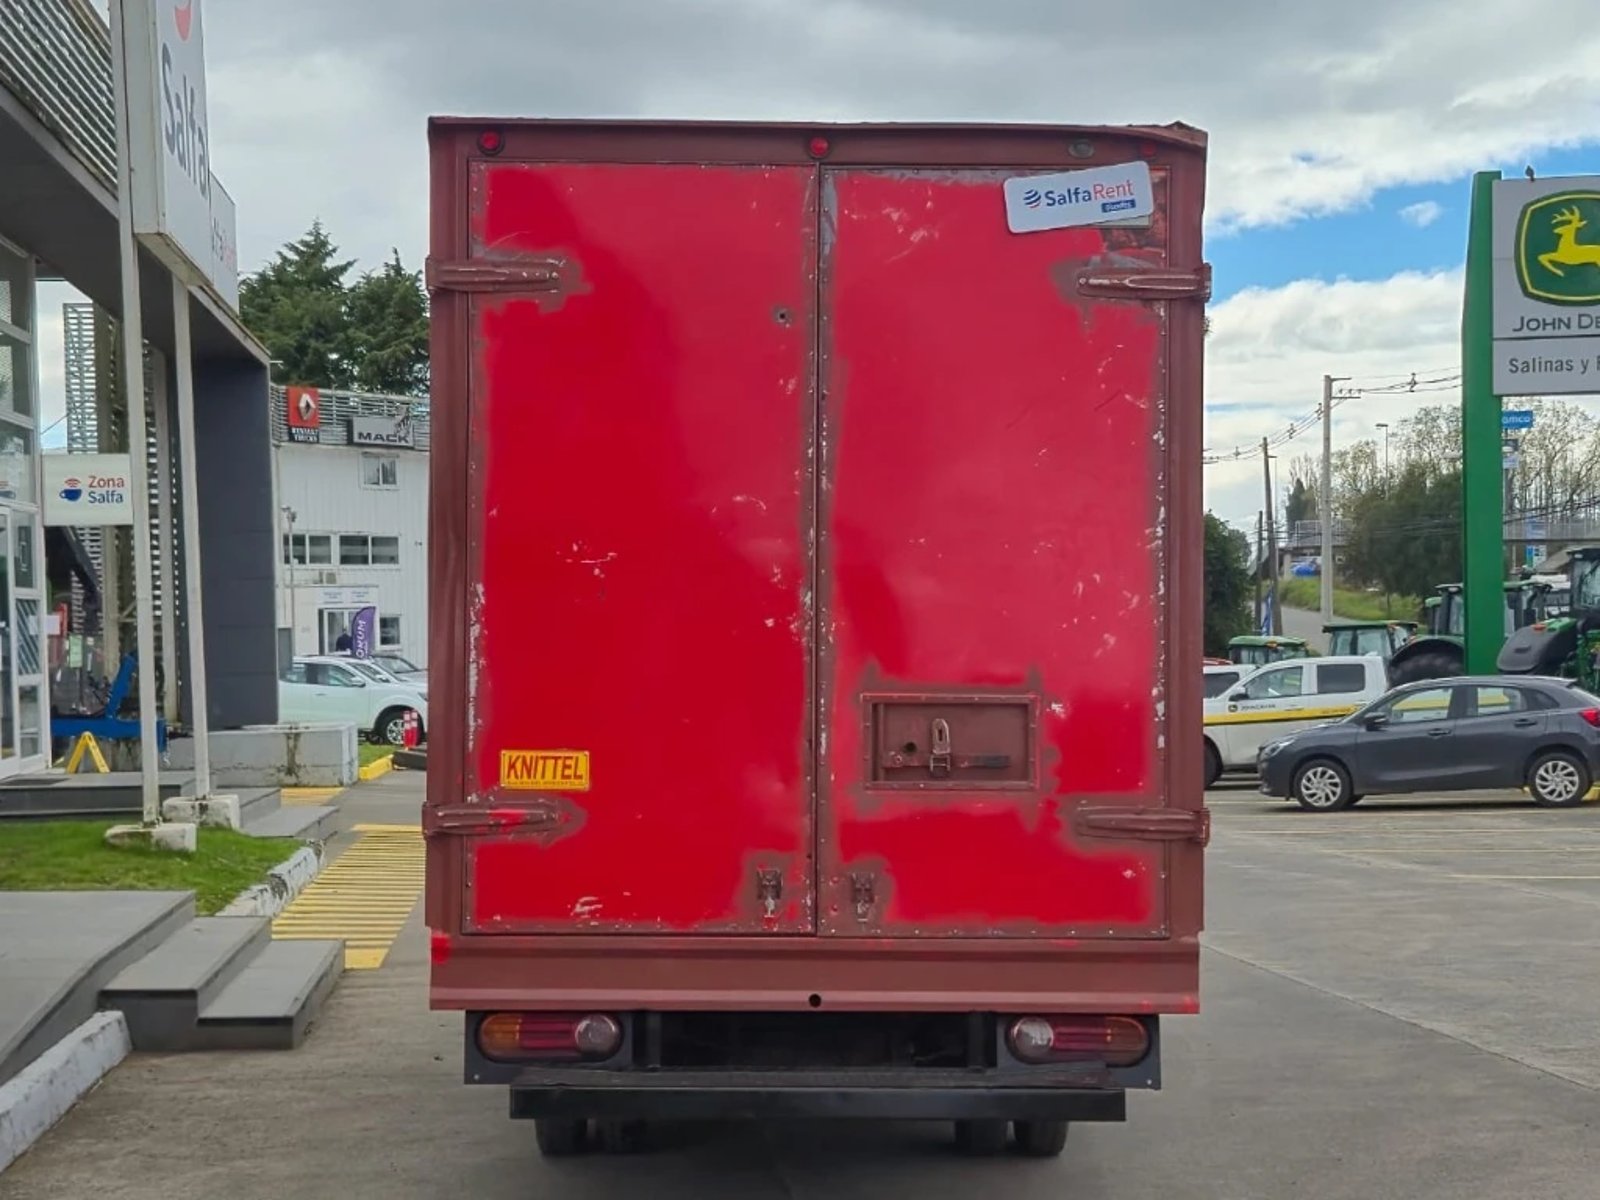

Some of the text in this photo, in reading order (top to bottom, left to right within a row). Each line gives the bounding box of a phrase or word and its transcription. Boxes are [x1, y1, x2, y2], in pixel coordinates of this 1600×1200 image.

[161, 41, 208, 198] Salfa
[1044, 180, 1135, 207] SalfaRent
[1512, 316, 1572, 332] JOHN
[1508, 356, 1575, 374] Salinas
[1580, 359, 1590, 375] y
[358, 432, 410, 443] MACK
[88, 475, 125, 488] Zona
[88, 490, 124, 504] Salfa
[506, 755, 584, 780] KNITTEL
